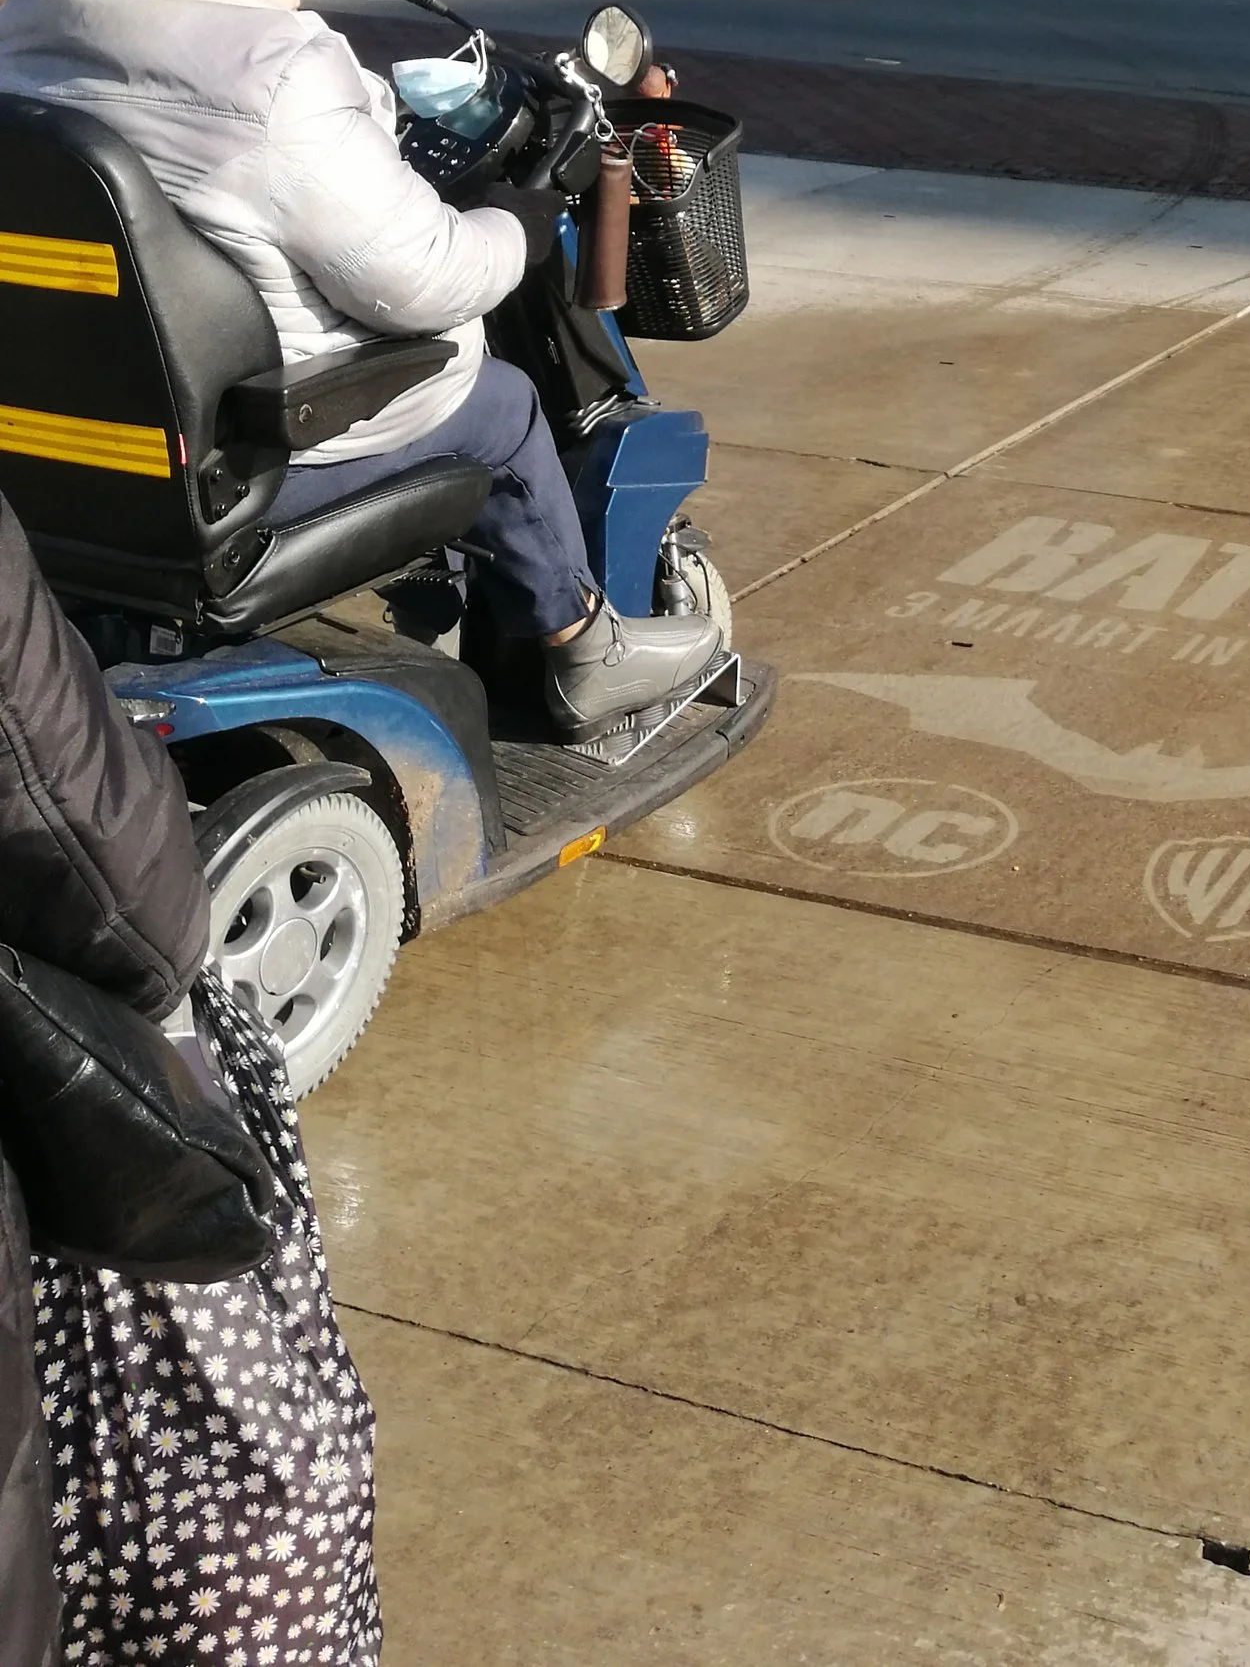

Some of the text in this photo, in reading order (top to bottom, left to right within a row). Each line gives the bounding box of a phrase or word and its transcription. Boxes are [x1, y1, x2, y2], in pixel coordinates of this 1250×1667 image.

[884, 590, 941, 619] 3
[939, 598, 1169, 655] MAART
[1171, 633, 1250, 667] IN
[790, 791, 995, 864] DC
